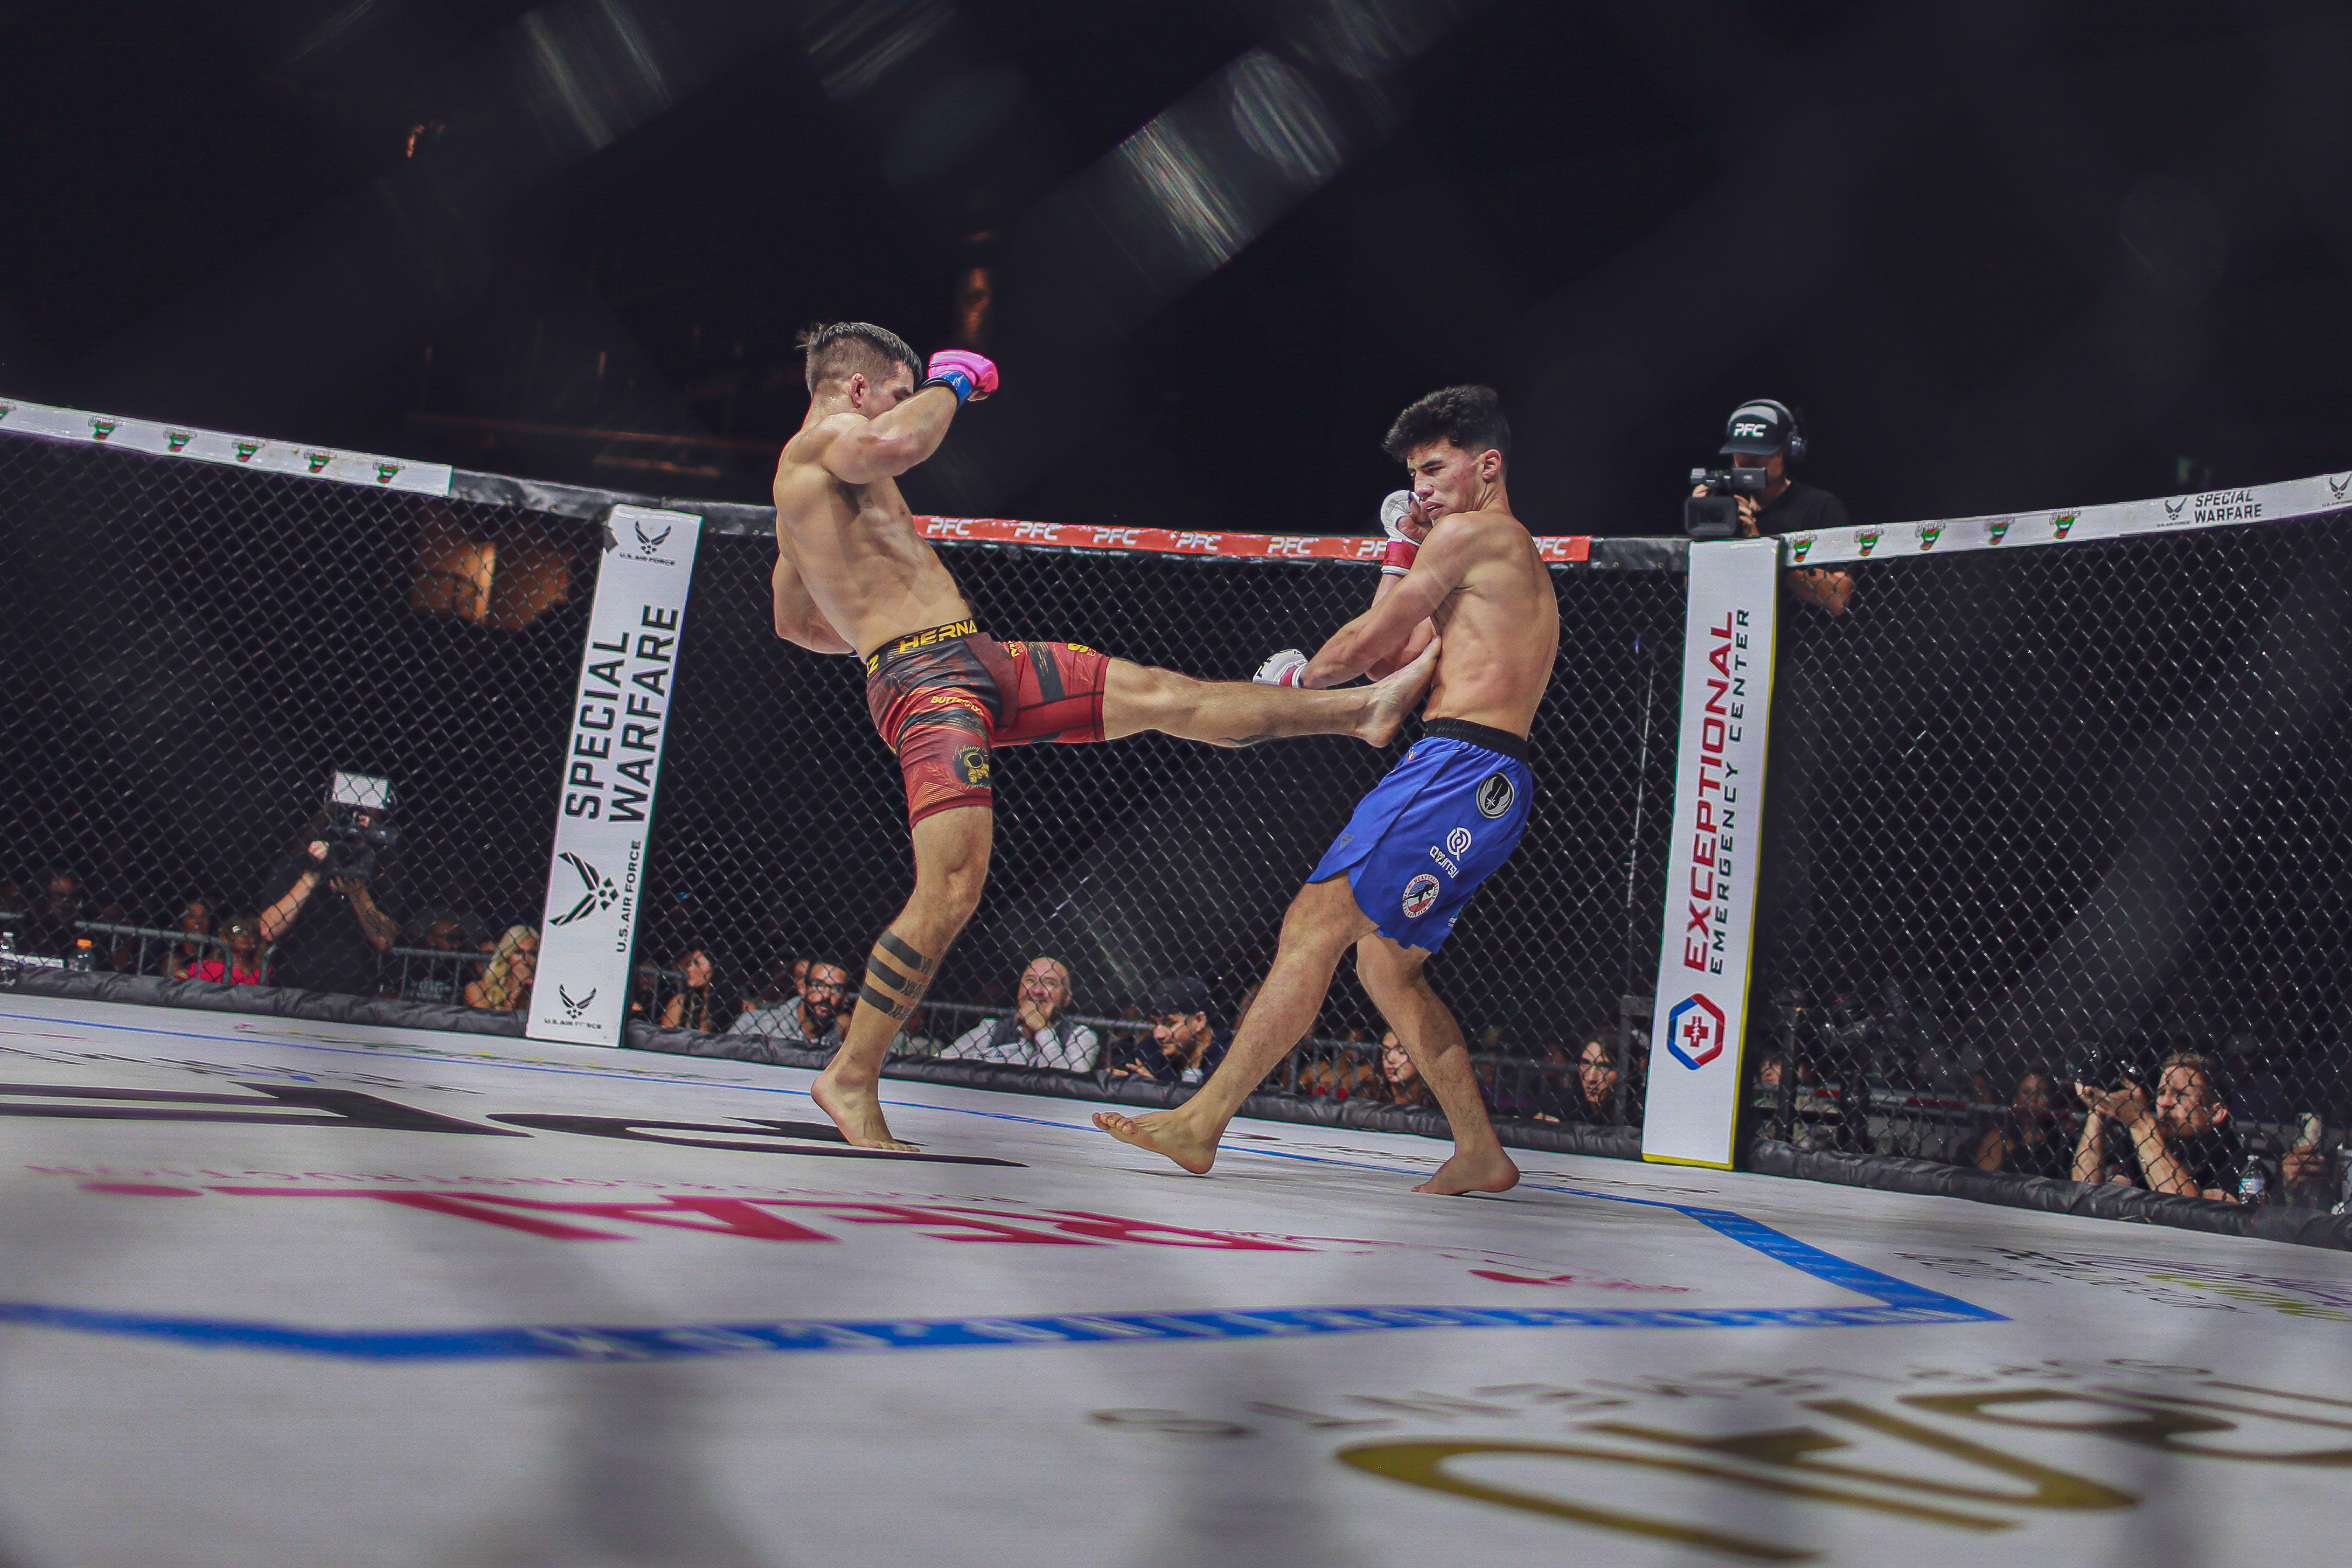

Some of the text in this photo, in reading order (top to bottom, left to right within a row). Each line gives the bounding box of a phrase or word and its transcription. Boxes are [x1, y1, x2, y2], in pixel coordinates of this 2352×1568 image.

[1733, 423, 1767, 437] PFC
[2195, 489, 2253, 507] SPECIAL
[2194, 503, 2262, 524] WARFARE
[926, 517, 974, 536] PFC
[1014, 521, 1059, 540] PFC
[1092, 527, 1141, 544] PFC
[1175, 532, 1222, 551] PFC
[1267, 537, 1315, 555] PFC
[1356, 540, 1387, 557] PF
[609, 604, 679, 822] WARFARE
[565, 632, 629, 819] SPECIAL
[1684, 611, 1732, 971] EXCEPTIONAL
[1710, 609, 1749, 975] EMERGENCY CENTER
[617, 839, 641, 952] U.S. AIR FORCE
